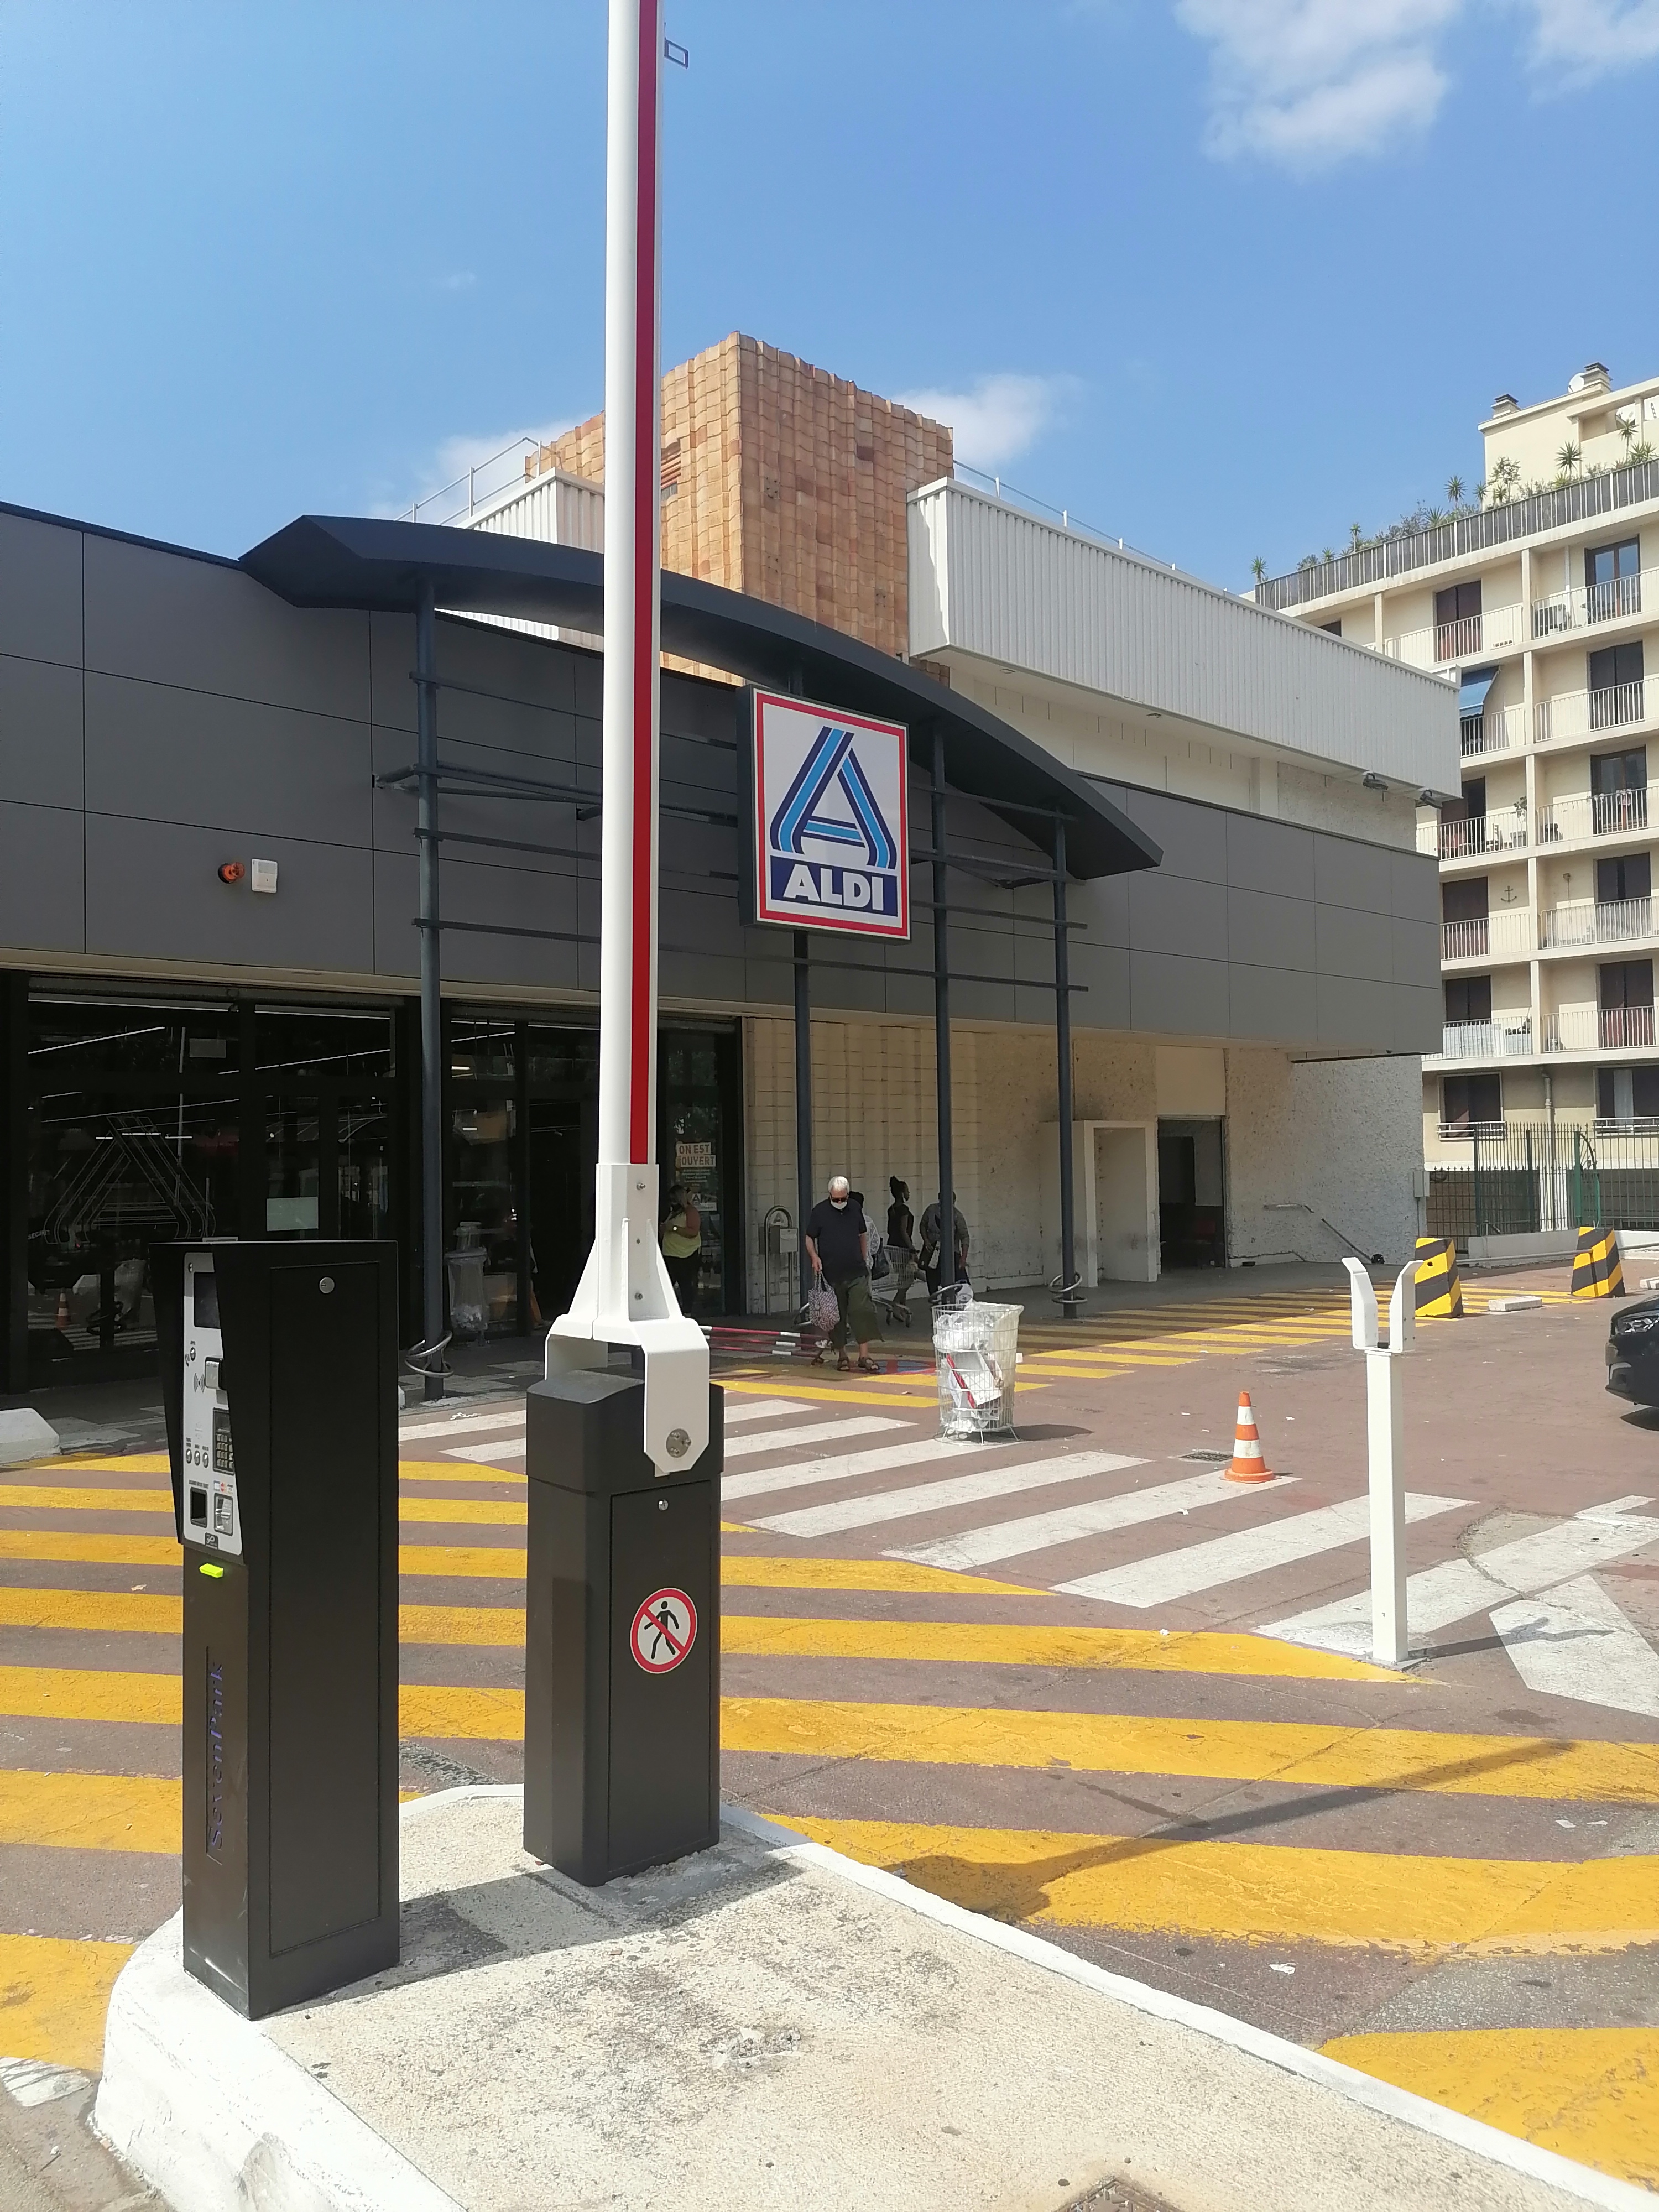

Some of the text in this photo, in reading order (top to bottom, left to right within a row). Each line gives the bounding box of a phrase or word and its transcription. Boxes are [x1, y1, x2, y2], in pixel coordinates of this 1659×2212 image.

[782, 864, 884, 911] ALDI
[679, 1144, 710, 1154] ON EST
[681, 1156, 715, 1165] OUVERT
